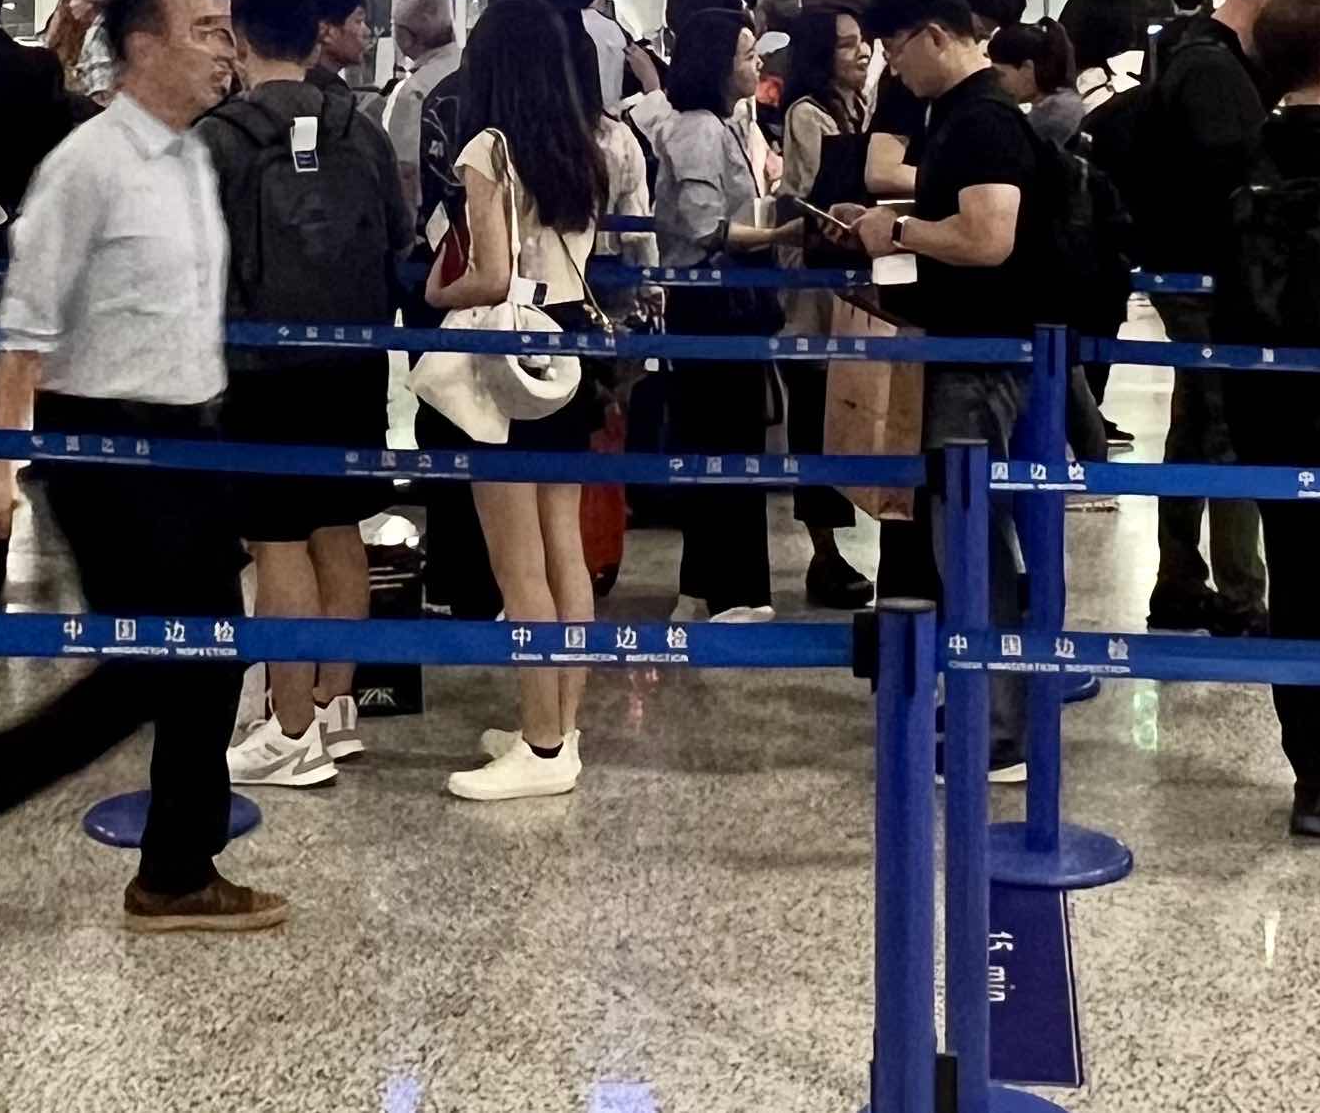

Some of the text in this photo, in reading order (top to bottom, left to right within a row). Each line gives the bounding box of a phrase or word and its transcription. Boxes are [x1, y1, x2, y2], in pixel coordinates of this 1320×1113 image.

[62, 618, 235, 643] 中国边检
[510, 625, 689, 650] 中国边检
